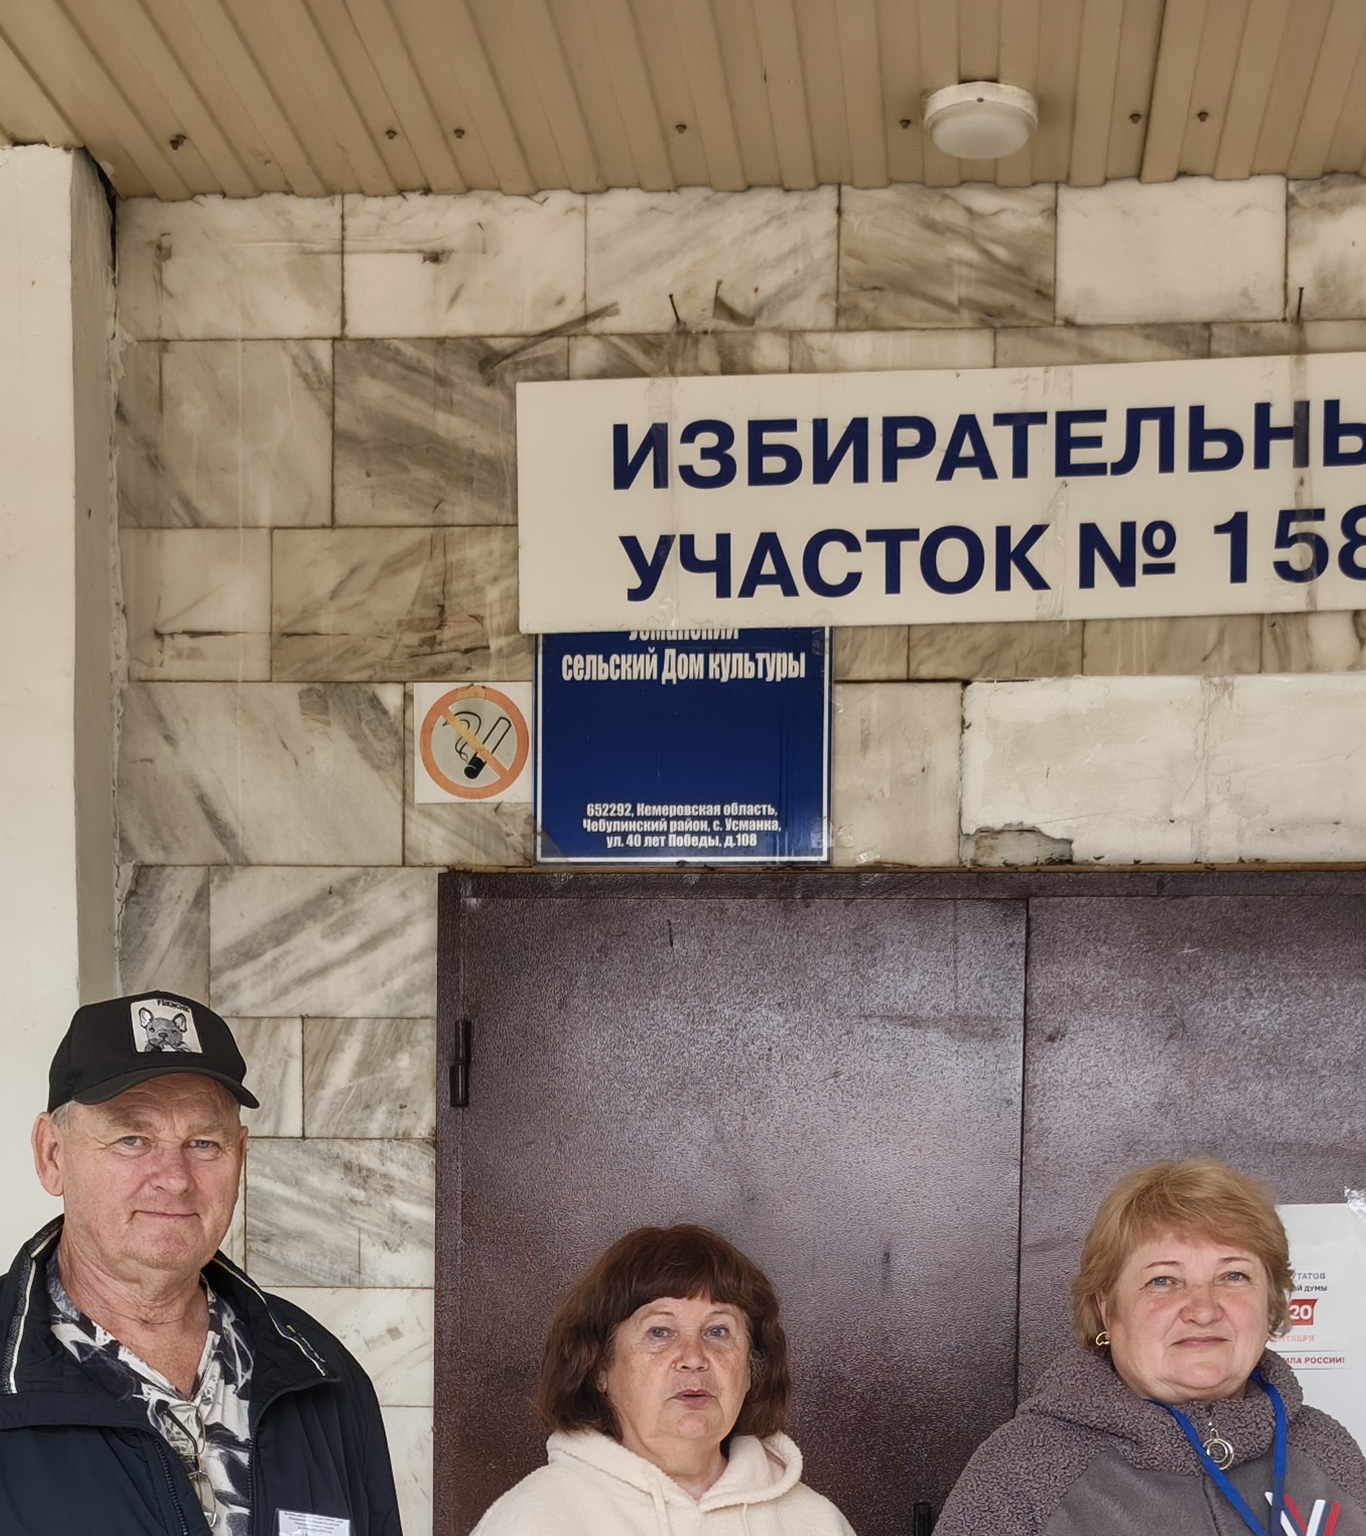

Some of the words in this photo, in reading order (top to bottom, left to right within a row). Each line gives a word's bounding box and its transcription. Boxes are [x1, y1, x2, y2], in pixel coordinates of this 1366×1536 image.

[619, 523, 1050, 602] УЧАСТОК
[1077, 519, 1177, 589] №
[562, 647, 657, 681] сельский
[661, 647, 704, 685] Дом
[708, 650, 806, 683] культуры
[586, 802, 635, 818] 652292,
[636, 802, 721, 818] Кемеровская
[723, 801, 779, 818] область,
[582, 817, 667, 834] Чебулинский
[669, 817, 711, 834] район,
[712, 820, 723, 832] с.
[725, 817, 782, 834] Усманка,
[606, 834, 625, 849] ул.
[626, 833, 642, 848] 40
[643, 834, 666, 848] лет
[724, 833, 758, 849] д.108
[1289, 1305, 1312, 1320] 20
